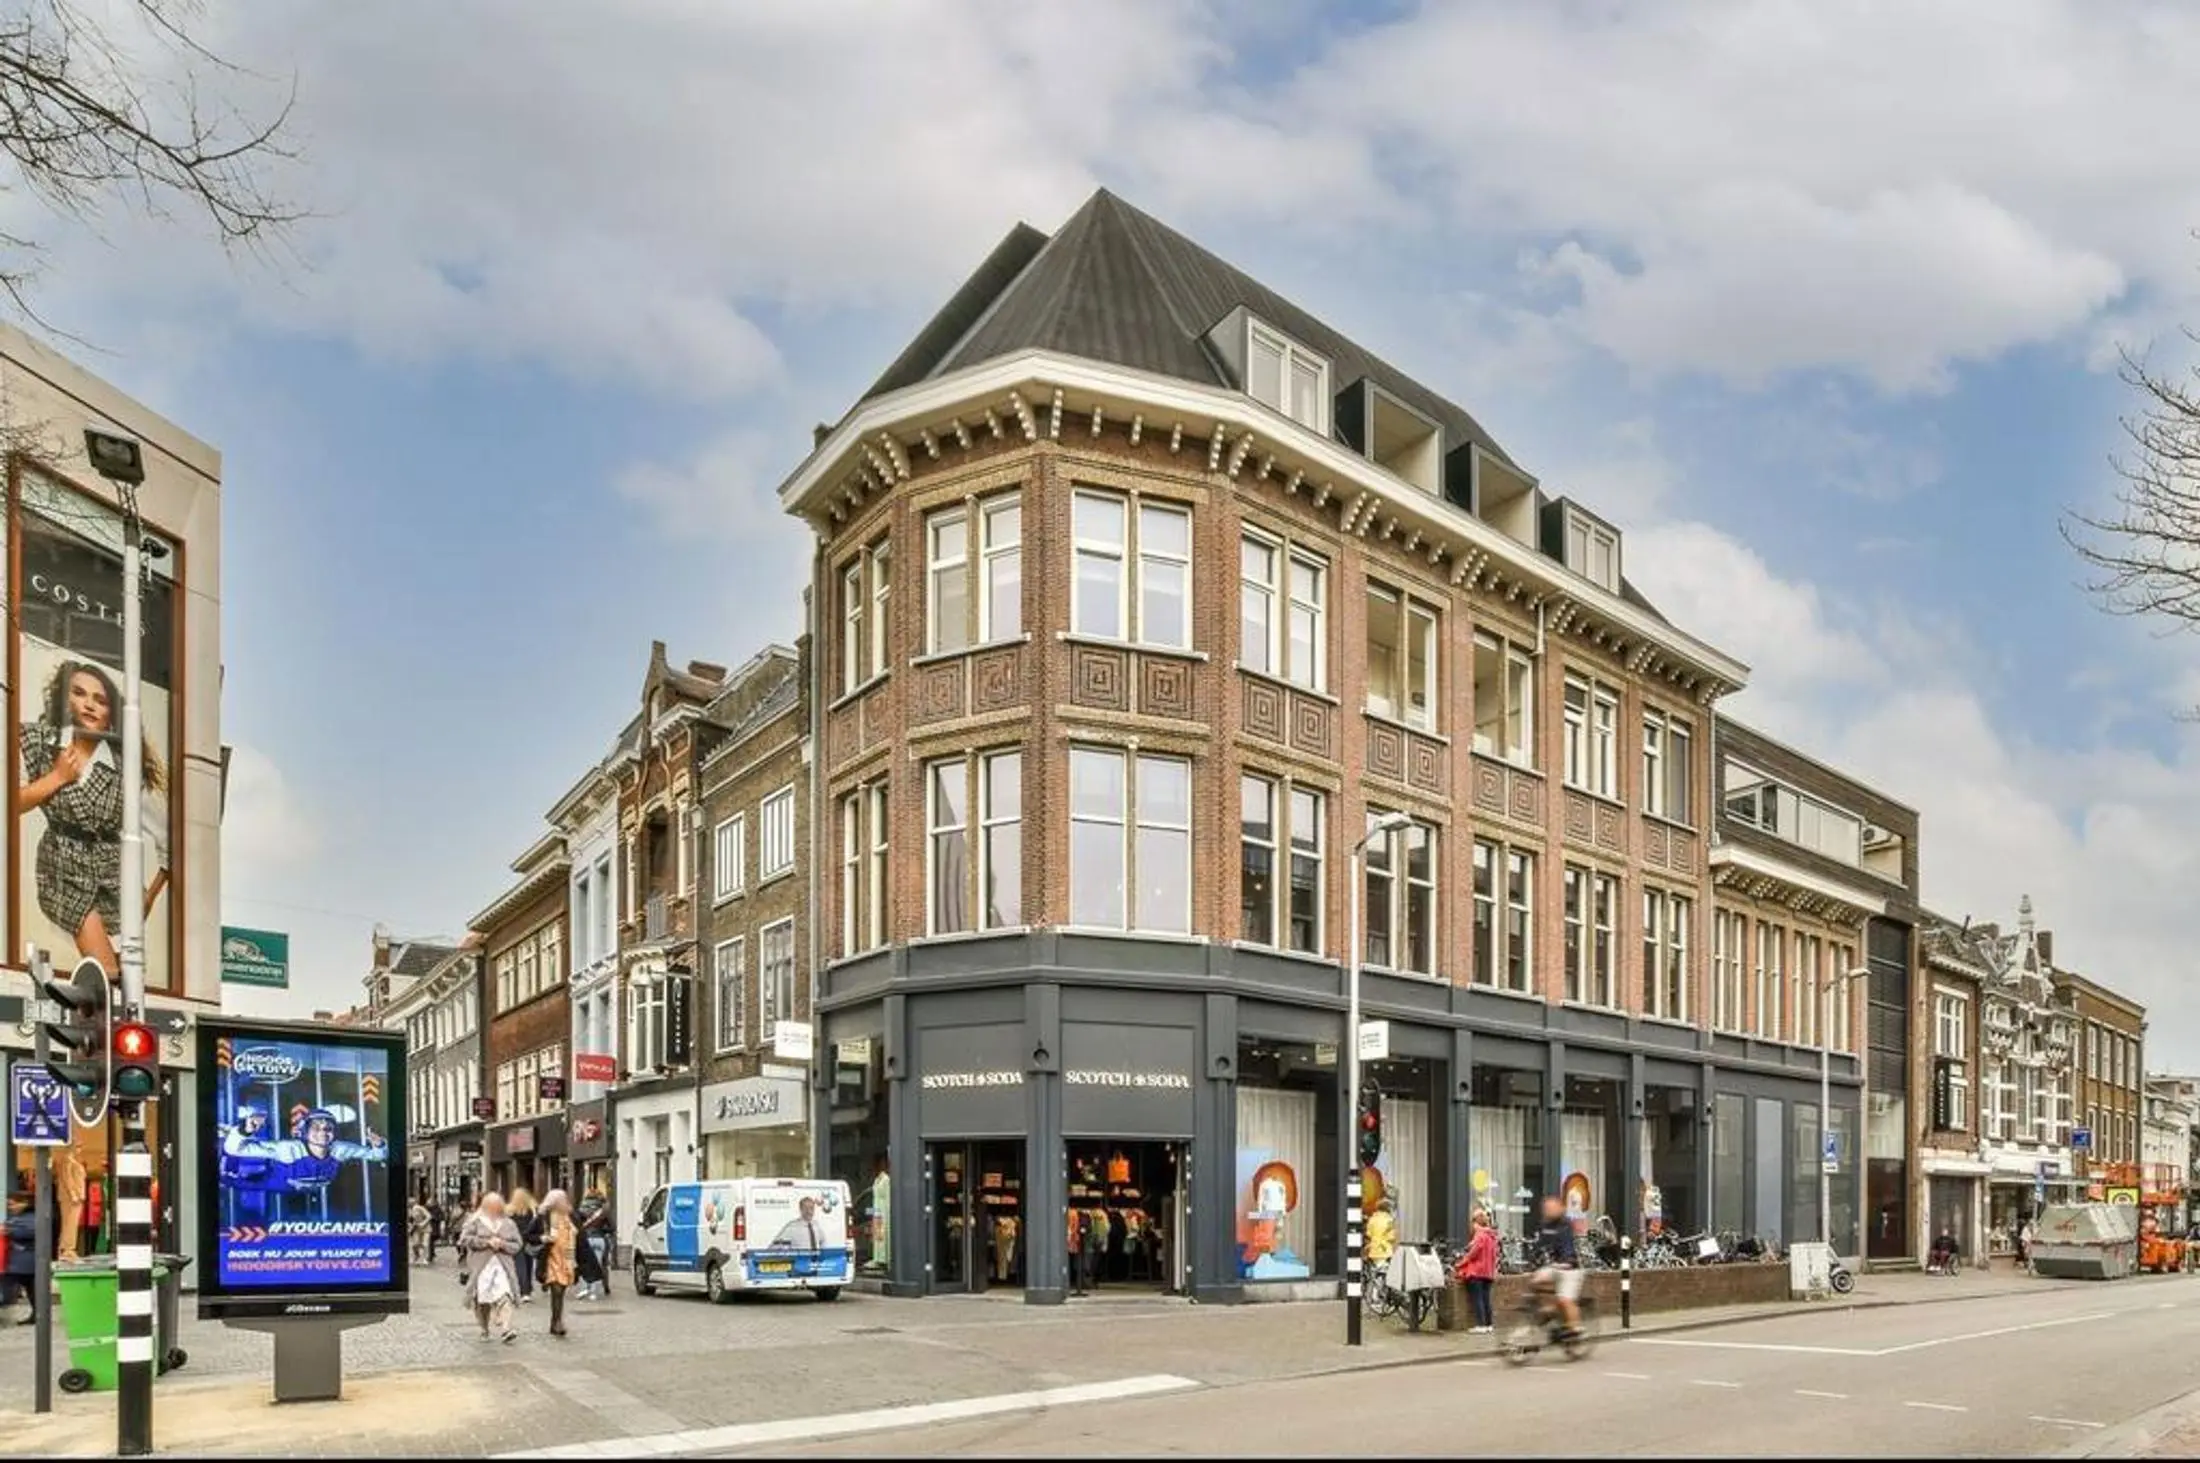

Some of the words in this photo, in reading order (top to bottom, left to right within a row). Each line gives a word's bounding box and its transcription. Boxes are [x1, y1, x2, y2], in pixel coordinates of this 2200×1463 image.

[922, 1073, 974, 1088] SCOTCH
[986, 1071, 1024, 1085] SODA
[1065, 1069, 1131, 1086] SCOTCH
[1147, 1074, 1190, 1089] SODA
[268, 1221, 386, 1234] #YOUCANFLY
